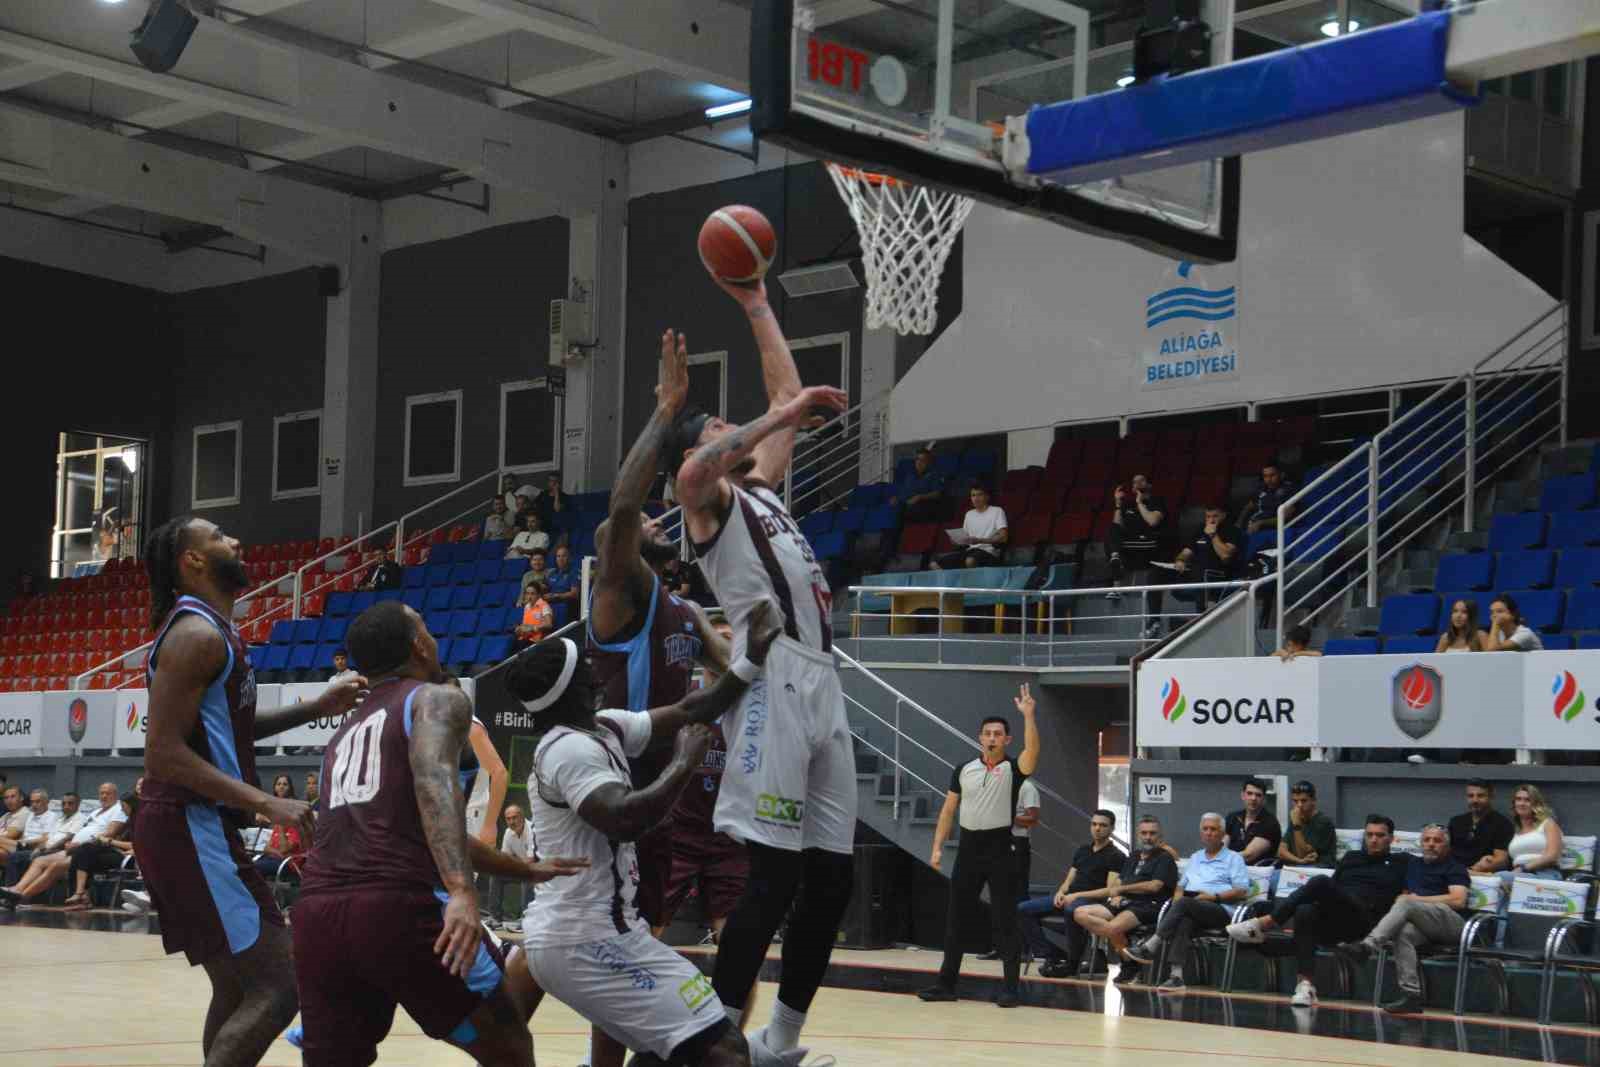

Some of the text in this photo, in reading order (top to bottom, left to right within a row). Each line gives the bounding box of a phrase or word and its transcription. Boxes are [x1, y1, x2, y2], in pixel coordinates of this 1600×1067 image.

[1160, 330, 1222, 355] ALİAĞA
[1146, 351, 1235, 382] BELEDİYESİ
[308, 711, 352, 730] SOCA
[1192, 698, 1294, 725] SOCAR
[330, 708, 387, 808] 10
[1145, 784, 1167, 796] VIP
